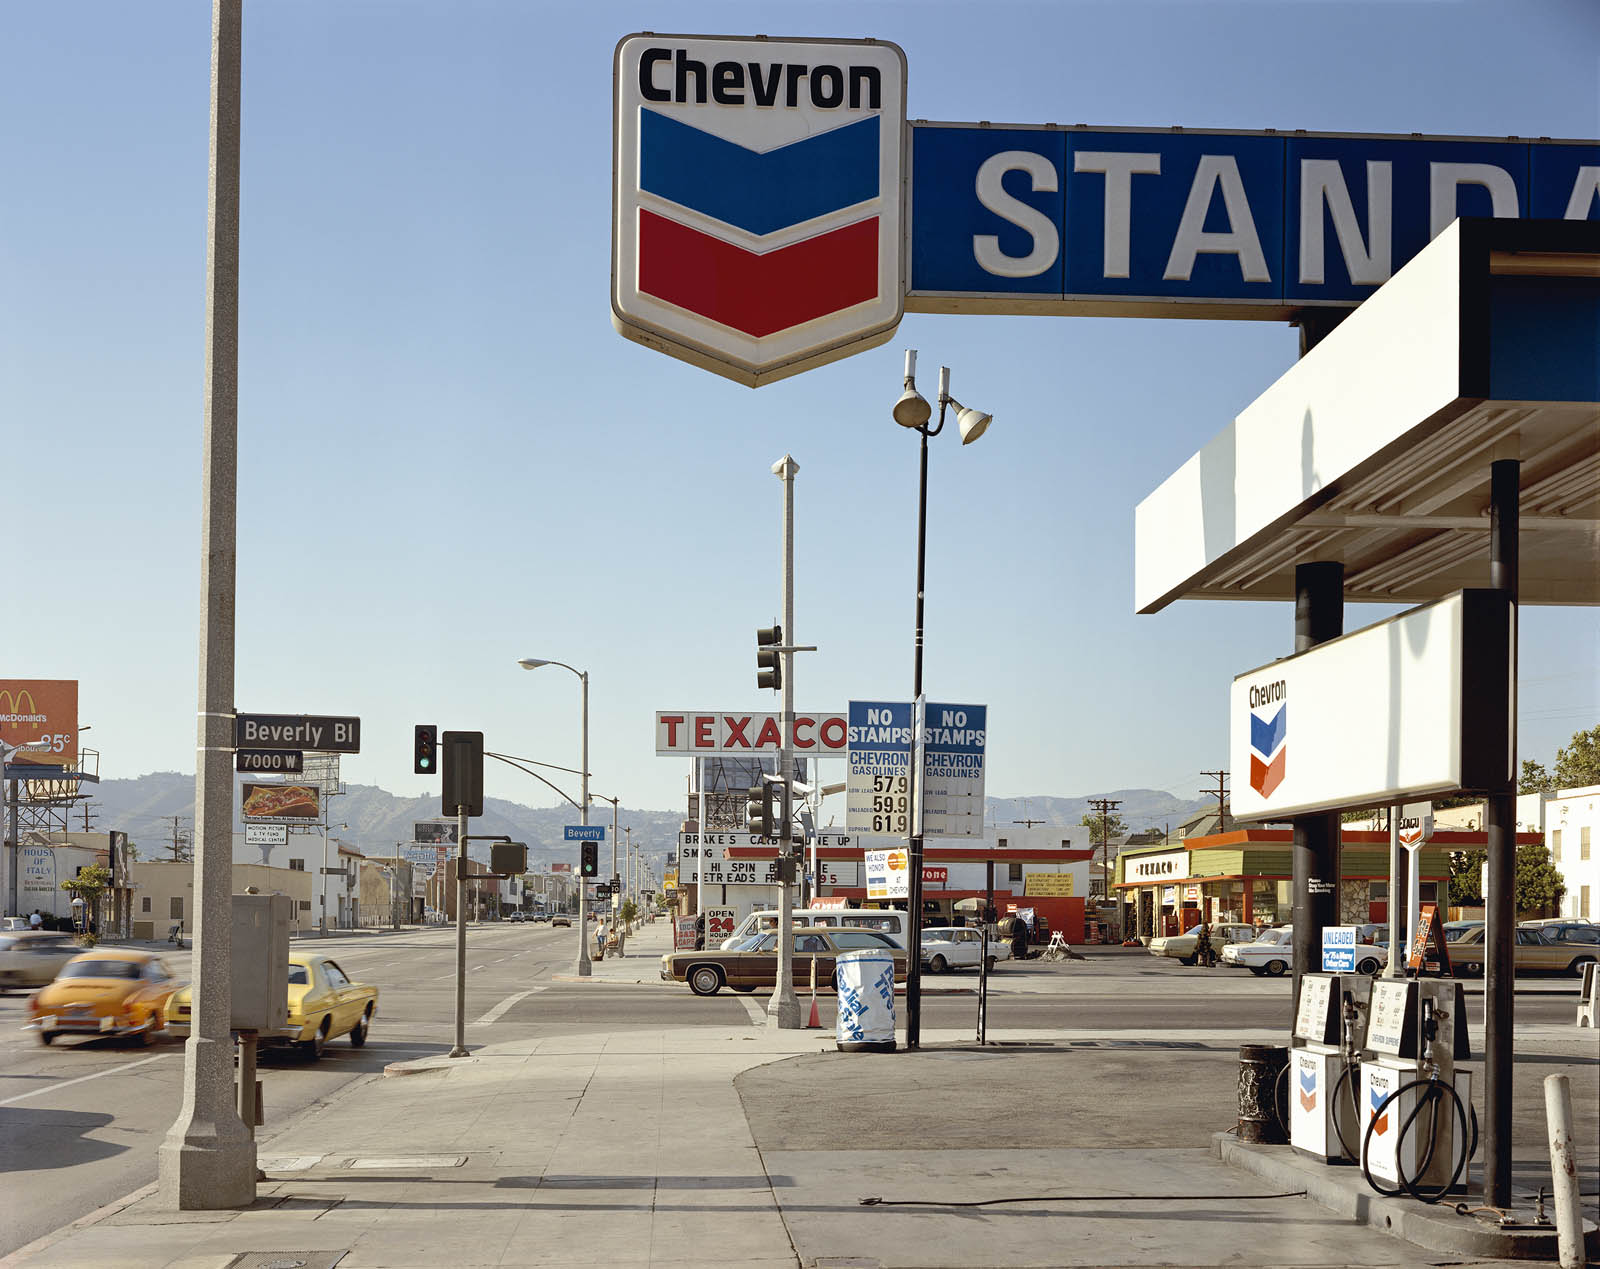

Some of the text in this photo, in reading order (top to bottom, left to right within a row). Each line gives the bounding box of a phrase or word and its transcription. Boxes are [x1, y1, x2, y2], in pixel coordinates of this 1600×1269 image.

[638, 47, 882, 109] Chevron
[972, 149, 1600, 287] STAND
[1249, 679, 1287, 709] Chevron
[867, 708, 893, 726] NO
[941, 710, 967, 727] NO
[245, 720, 353, 747] Beverly Bl
[660, 715, 848, 748] TEXACO
[848, 726, 912, 744] STAMPS
[924, 727, 985, 747] STAMPS
[243, 754, 296, 769] 7000 W
[850, 751, 909, 766] CHEVRON
[925, 753, 983, 769] CHEVRON
[852, 766, 906, 776] GASOLINES
[926, 768, 980, 778] GASOLINES
[873, 776, 908, 794] 57.9
[873, 795, 908, 814] 59.9
[872, 814, 907, 832] 61.9
[568, 828, 601, 839] Beverly
[685, 835, 737, 845] BRAKES
[838, 836, 851, 846] UP
[34, 857, 48, 865] OF
[683, 849, 713, 858] SMOG
[866, 854, 874, 862] WE
[26, 866, 50, 875] ITALY
[711, 863, 756, 873] HI SPIN
[1139, 860, 1173, 876] TEXACO
[692, 873, 756, 883] RETREADS
[708, 917, 735, 933] 24
[1323, 931, 1354, 945] UNLEADED
[1370, 1073, 1389, 1088] Chevron
